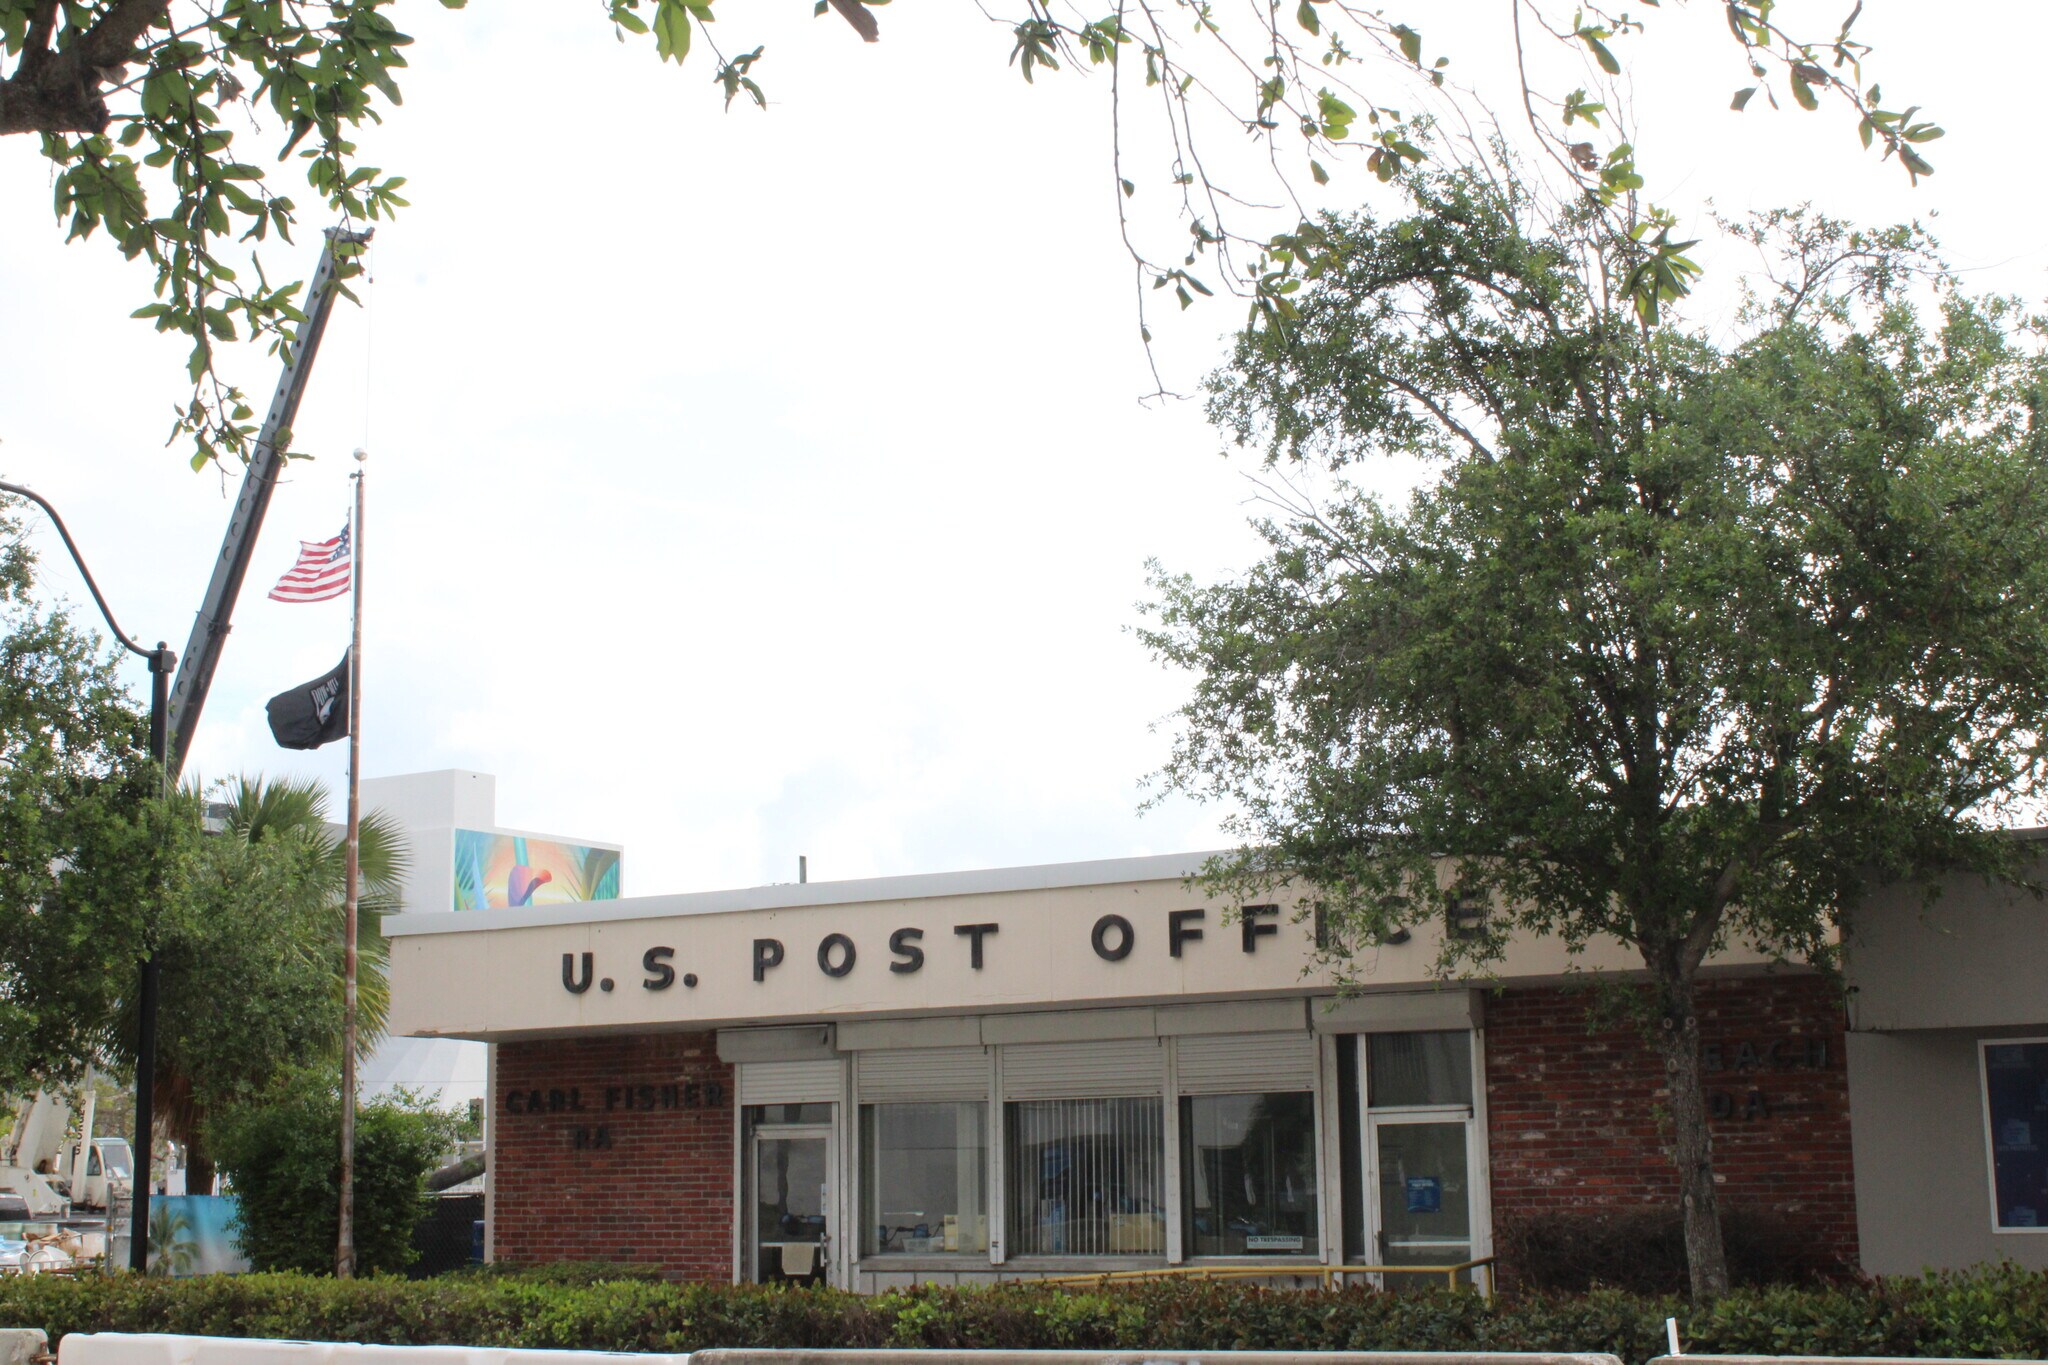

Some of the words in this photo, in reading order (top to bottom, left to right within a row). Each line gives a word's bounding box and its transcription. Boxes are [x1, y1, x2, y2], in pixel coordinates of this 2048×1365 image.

[561, 946, 698, 994] U.S.
[752, 922, 999, 982] POST
[1091, 888, 1488, 962] OFFICE
[505, 1087, 585, 1115] CARL
[606, 1081, 724, 1111] FISHER
